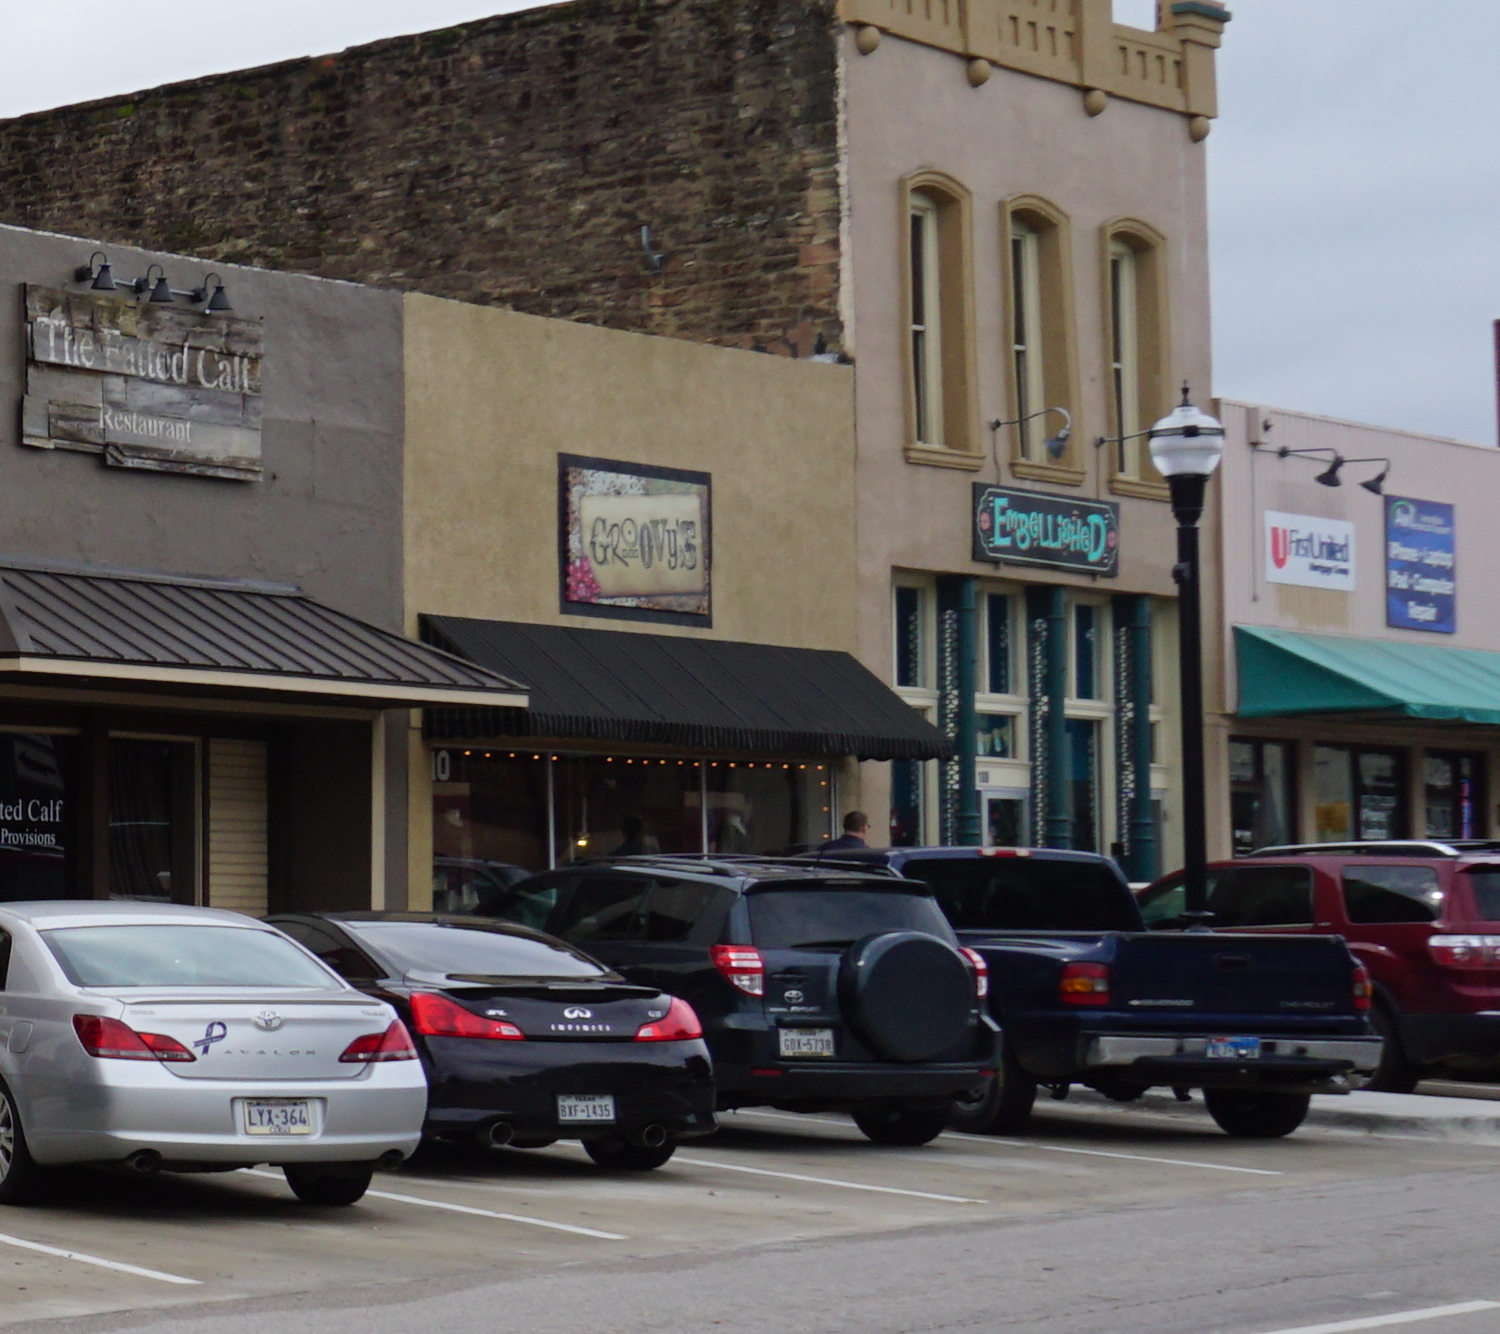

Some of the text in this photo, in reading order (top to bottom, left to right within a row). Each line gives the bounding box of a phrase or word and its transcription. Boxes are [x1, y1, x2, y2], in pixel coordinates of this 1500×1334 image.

[37, 317, 94, 367] The
[99, 403, 192, 444] Restaurant
[28, 799, 63, 822] Calf
[0, 828, 56, 845] Provisions
